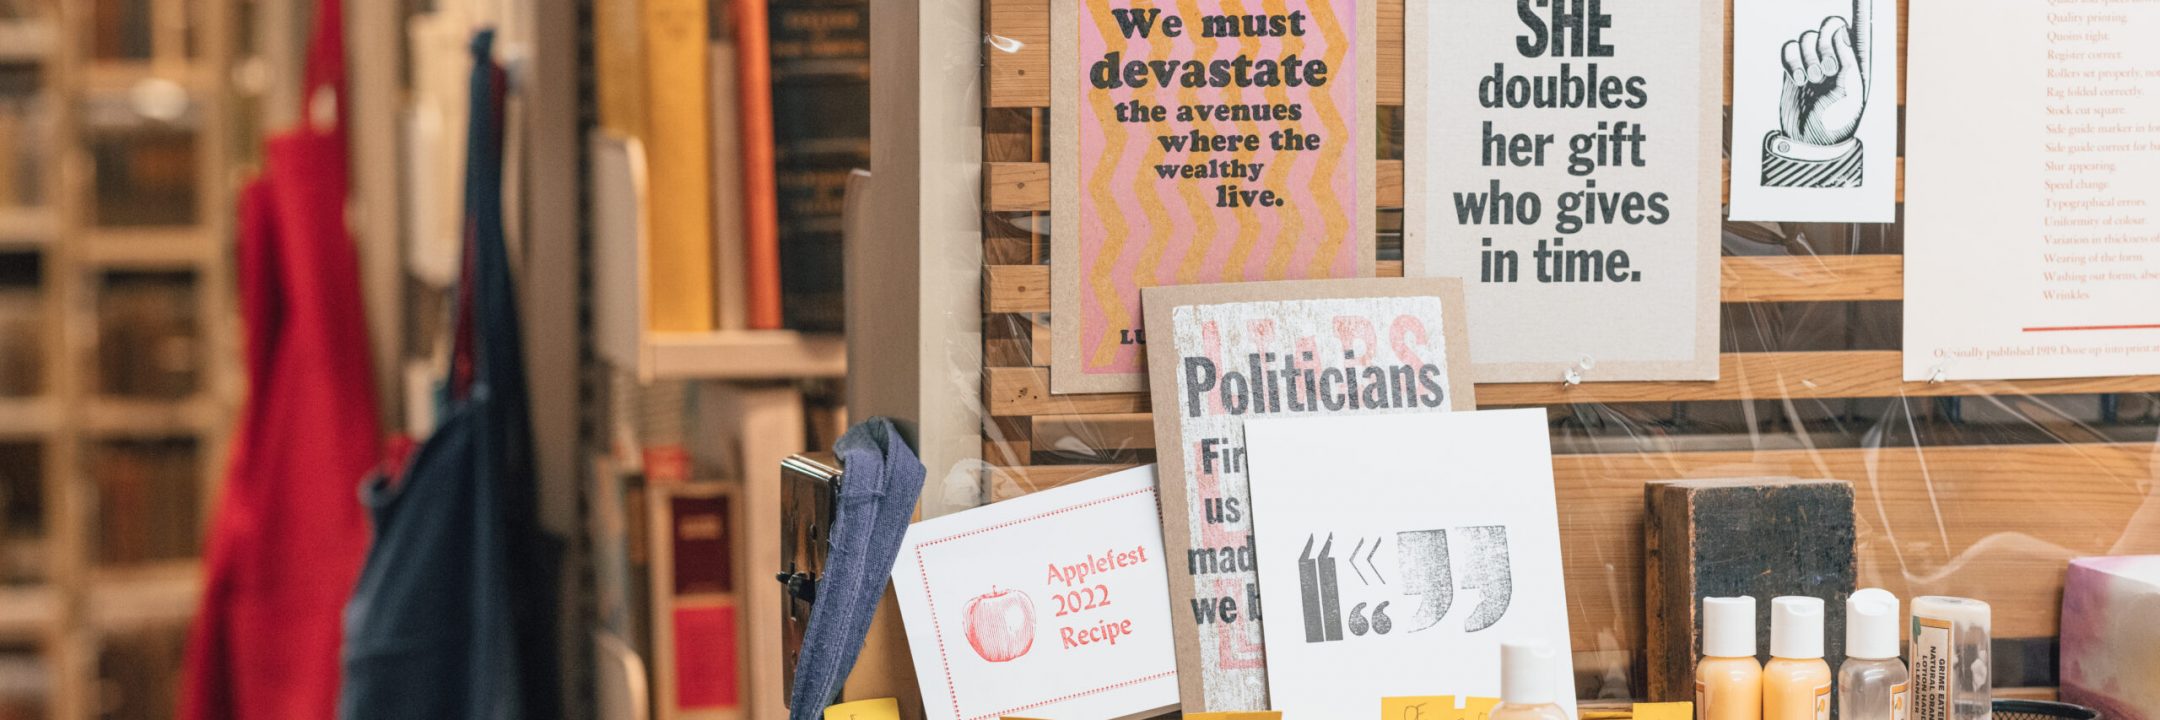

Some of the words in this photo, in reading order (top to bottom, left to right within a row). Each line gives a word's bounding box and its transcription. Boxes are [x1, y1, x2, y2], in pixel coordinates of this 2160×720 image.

[1111, 8, 1182, 39] We
[1201, 10, 1306, 37] must
[1516, 0, 1614, 58] SHE
[2047, 11, 2083, 24] Quality
[1090, 51, 1328, 89] devastate
[1479, 62, 1648, 109] doubles
[1114, 99, 1167, 122] the
[1176, 103, 1302, 121] avenues
[1157, 129, 1260, 152] where
[1269, 128, 1320, 151] the
[1482, 121, 1554, 167] her
[1567, 121, 1646, 176] gift
[1154, 159, 1264, 182] wealthy
[2044, 179, 2072, 192] Speed
[1216, 185, 1284, 208] live.
[1453, 179, 1541, 225] who
[1555, 179, 1670, 234] gives
[1481, 237, 1518, 282] in
[1533, 238, 1641, 283] time.
[1184, 349, 1444, 417] Politicians
[1205, 497, 1241, 525] us
[1047, 545, 1148, 587] Applefest
[1052, 584, 1112, 617] 2022
[1191, 593, 1237, 625] we
[1060, 619, 1133, 650] Recipe
